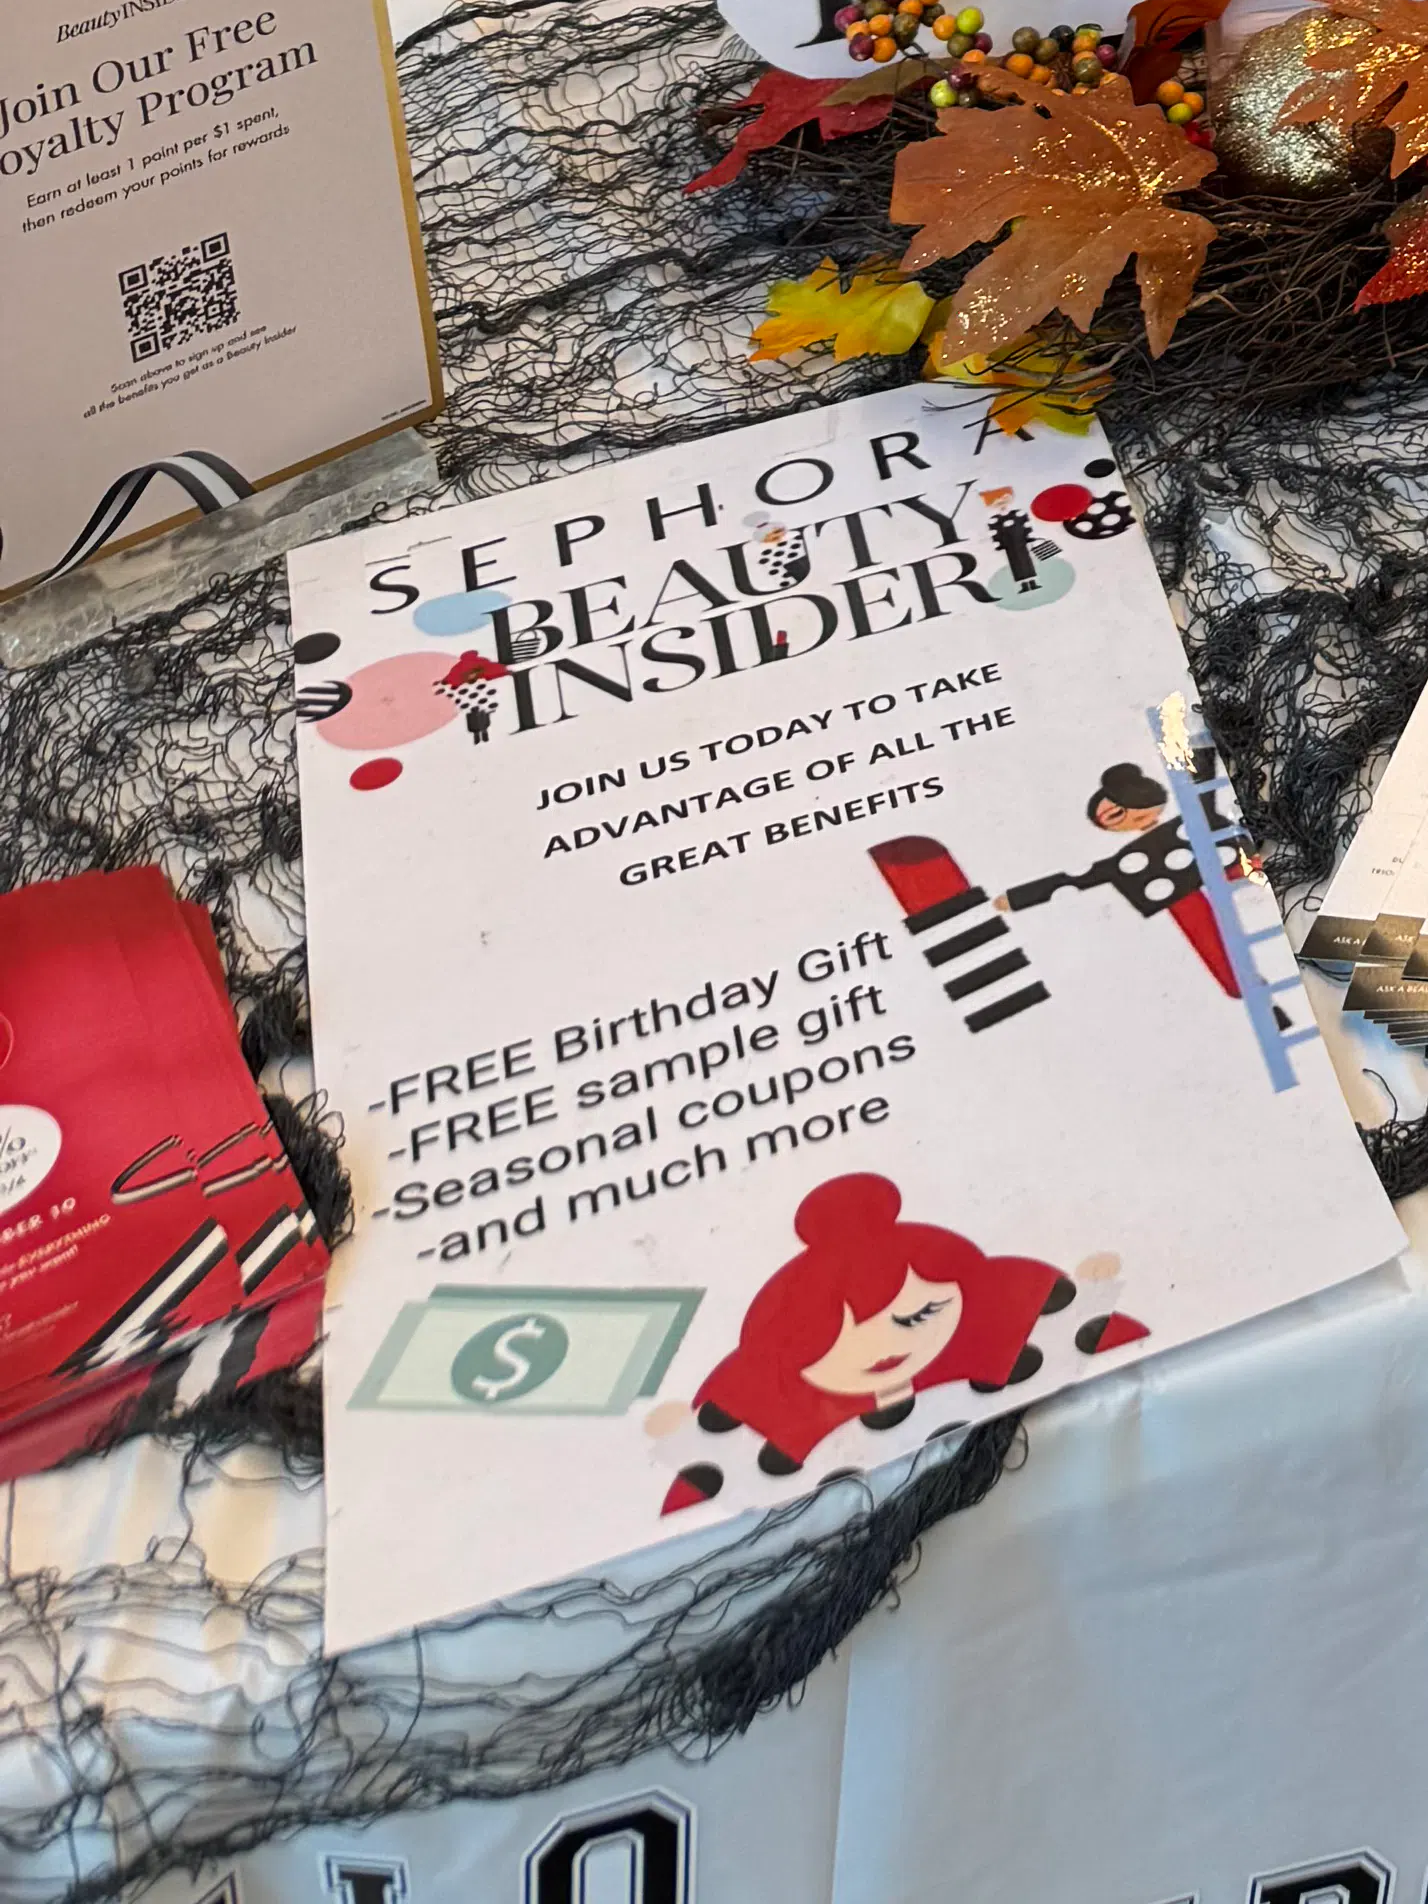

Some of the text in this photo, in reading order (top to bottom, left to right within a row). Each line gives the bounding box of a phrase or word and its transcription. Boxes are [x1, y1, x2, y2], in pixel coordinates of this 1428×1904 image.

[0, 10, 278, 140] Join Our Free
[0, 41, 319, 177] oyalty Program
[22, 123, 291, 234] then redeem your points for rewards
[27, 106, 280, 209] Earn at least 1 point per $1 spent,
[110, 374, 139, 395] Scan
[174, 355, 187, 369] to
[369, 418, 1035, 615] SEPHORA
[482, 480, 977, 663] BEAUTY
[504, 549, 1001, 736] INSIDER
[536, 662, 1003, 811] JOIN US TODAY TO TAKE
[543, 706, 1018, 860] ADVANTAGE OF ALL THE
[618, 775, 947, 888] GREAT BENEFITS
[366, 930, 894, 1118] -FREE Birthday Gift
[387, 983, 889, 1164] -FREE sample gift
[370, 1030, 918, 1223] -Seasonal coupons
[416, 1095, 892, 1264] -and much more
